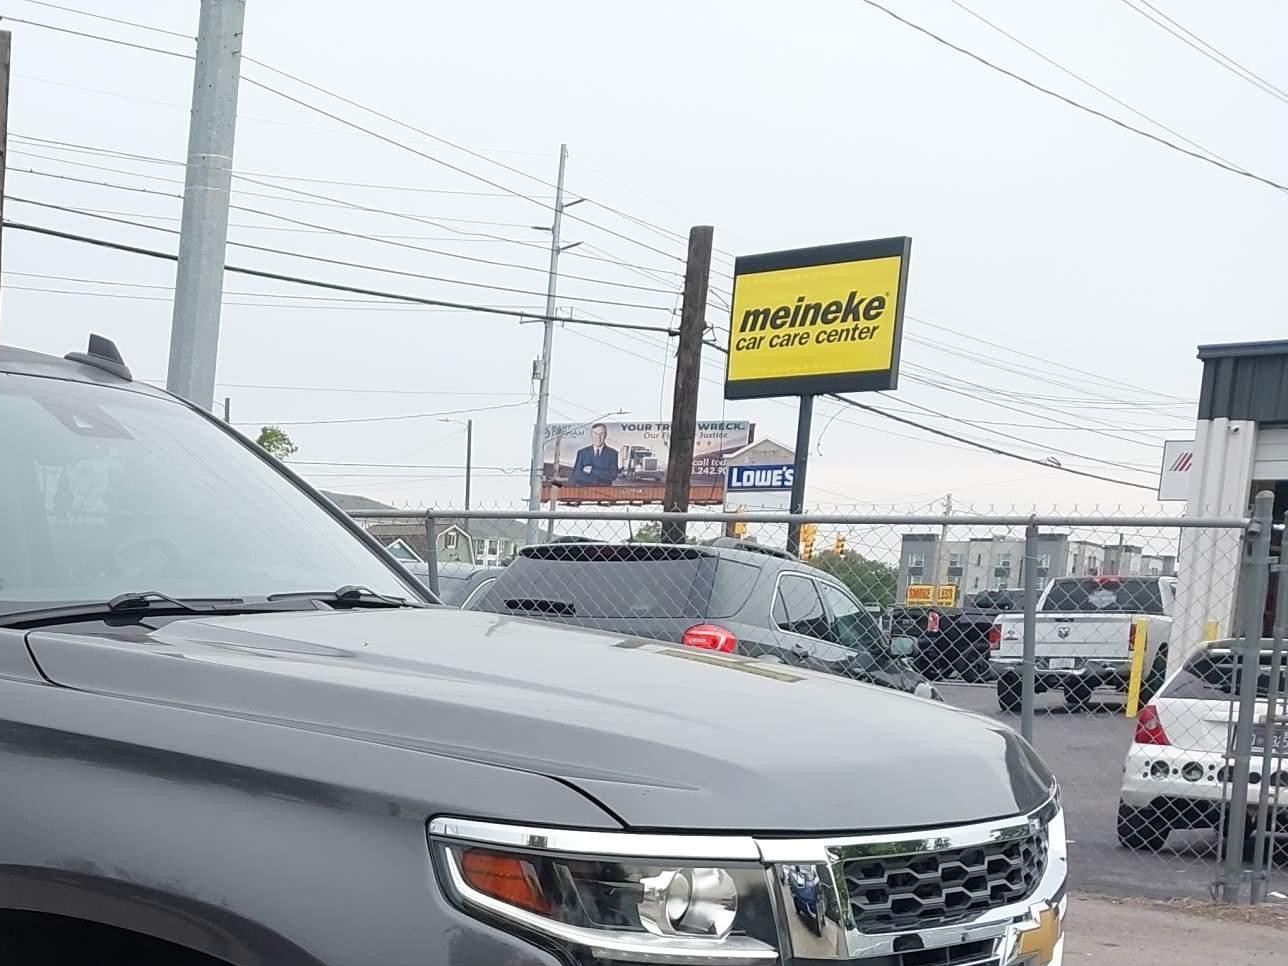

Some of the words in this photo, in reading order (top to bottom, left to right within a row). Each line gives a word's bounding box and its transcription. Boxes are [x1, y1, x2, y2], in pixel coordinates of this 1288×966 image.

[739, 290, 886, 333] meineke
[735, 333, 765, 351] car
[768, 331, 810, 349] care
[815, 324, 880, 345] center
[621, 423, 653, 431] YOUR
[732, 466, 794, 487] LOWE'S
